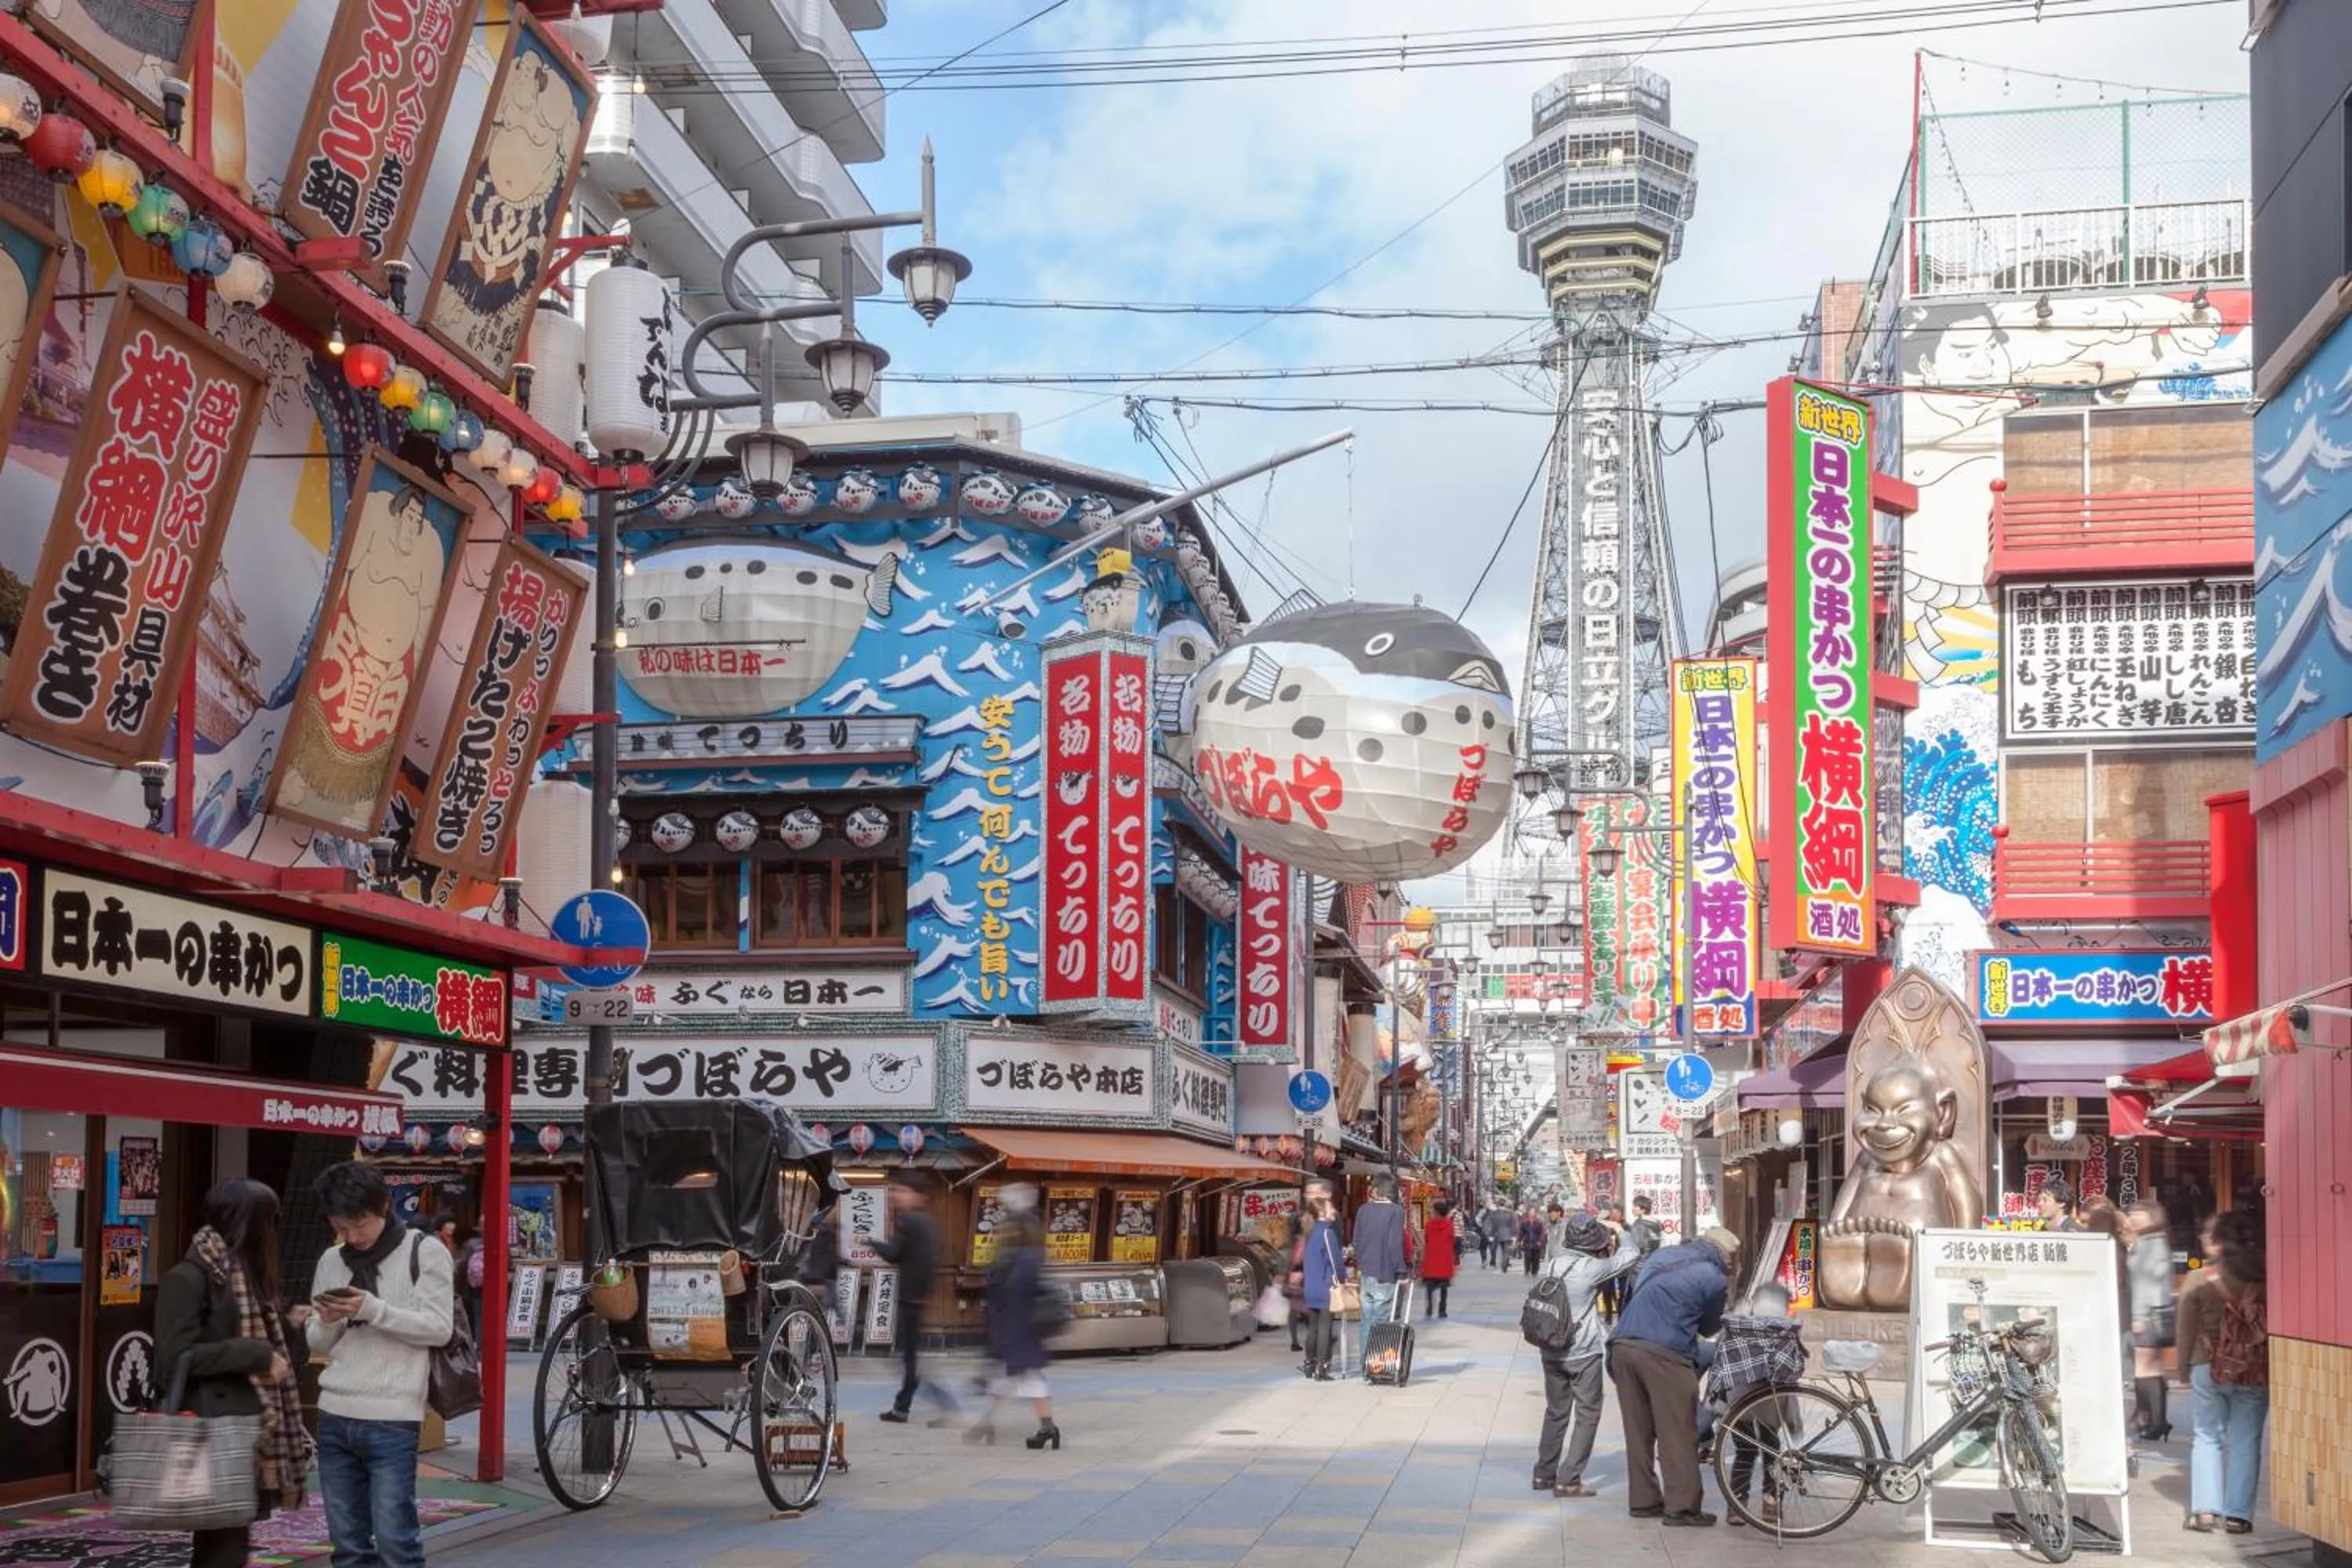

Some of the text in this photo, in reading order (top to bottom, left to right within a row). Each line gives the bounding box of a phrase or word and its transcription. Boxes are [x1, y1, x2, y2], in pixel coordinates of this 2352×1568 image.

[1797, 394, 1864, 445] 新世界
[32, 330, 196, 724] 横綱巻き
[107, 379, 239, 736] 盛り沢山具材
[1809, 441, 1854, 710] 日本一の串かつ
[639, 650, 786, 675] 私の味は日本一
[1680, 667, 1747, 691] 新世界
[2066, 658, 2089, 728] 紅しょうが
[2089, 659, 2112, 728] にんにく
[2114, 656, 2138, 728] 玉ねぎ
[2140, 655, 2161, 726] 山芋
[2165, 655, 2187, 725] しし唐
[2189, 654, 2212, 724] れんこん
[2214, 652, 2238, 723] 銀杏
[435, 561, 545, 852] 揚げたこ焼き
[1059, 674, 1091, 757] 名物
[1112, 673, 1142, 754] 名物
[1693, 696, 1736, 874] 日本一の串かつ
[1802, 715, 1866, 898] 横綱
[979, 695, 1015, 999] 安うて何んでも旨い
[52, 890, 303, 1001] 日本一の串かつ
[1682, 881, 1748, 1000] 横綱
[1809, 901, 1862, 942] 酒処
[322, 943, 503, 1041] 新世界 日本一の串かつ 横綱
[1987, 960, 2008, 1015] 新世界
[2011, 970, 2158, 1005] 日本一の串かつ
[637, 1048, 851, 1097] づぼらや
[976, 1058, 1144, 1095] づぼらや本店
[263, 1099, 401, 1135] 日本一の串かつ 横綱
